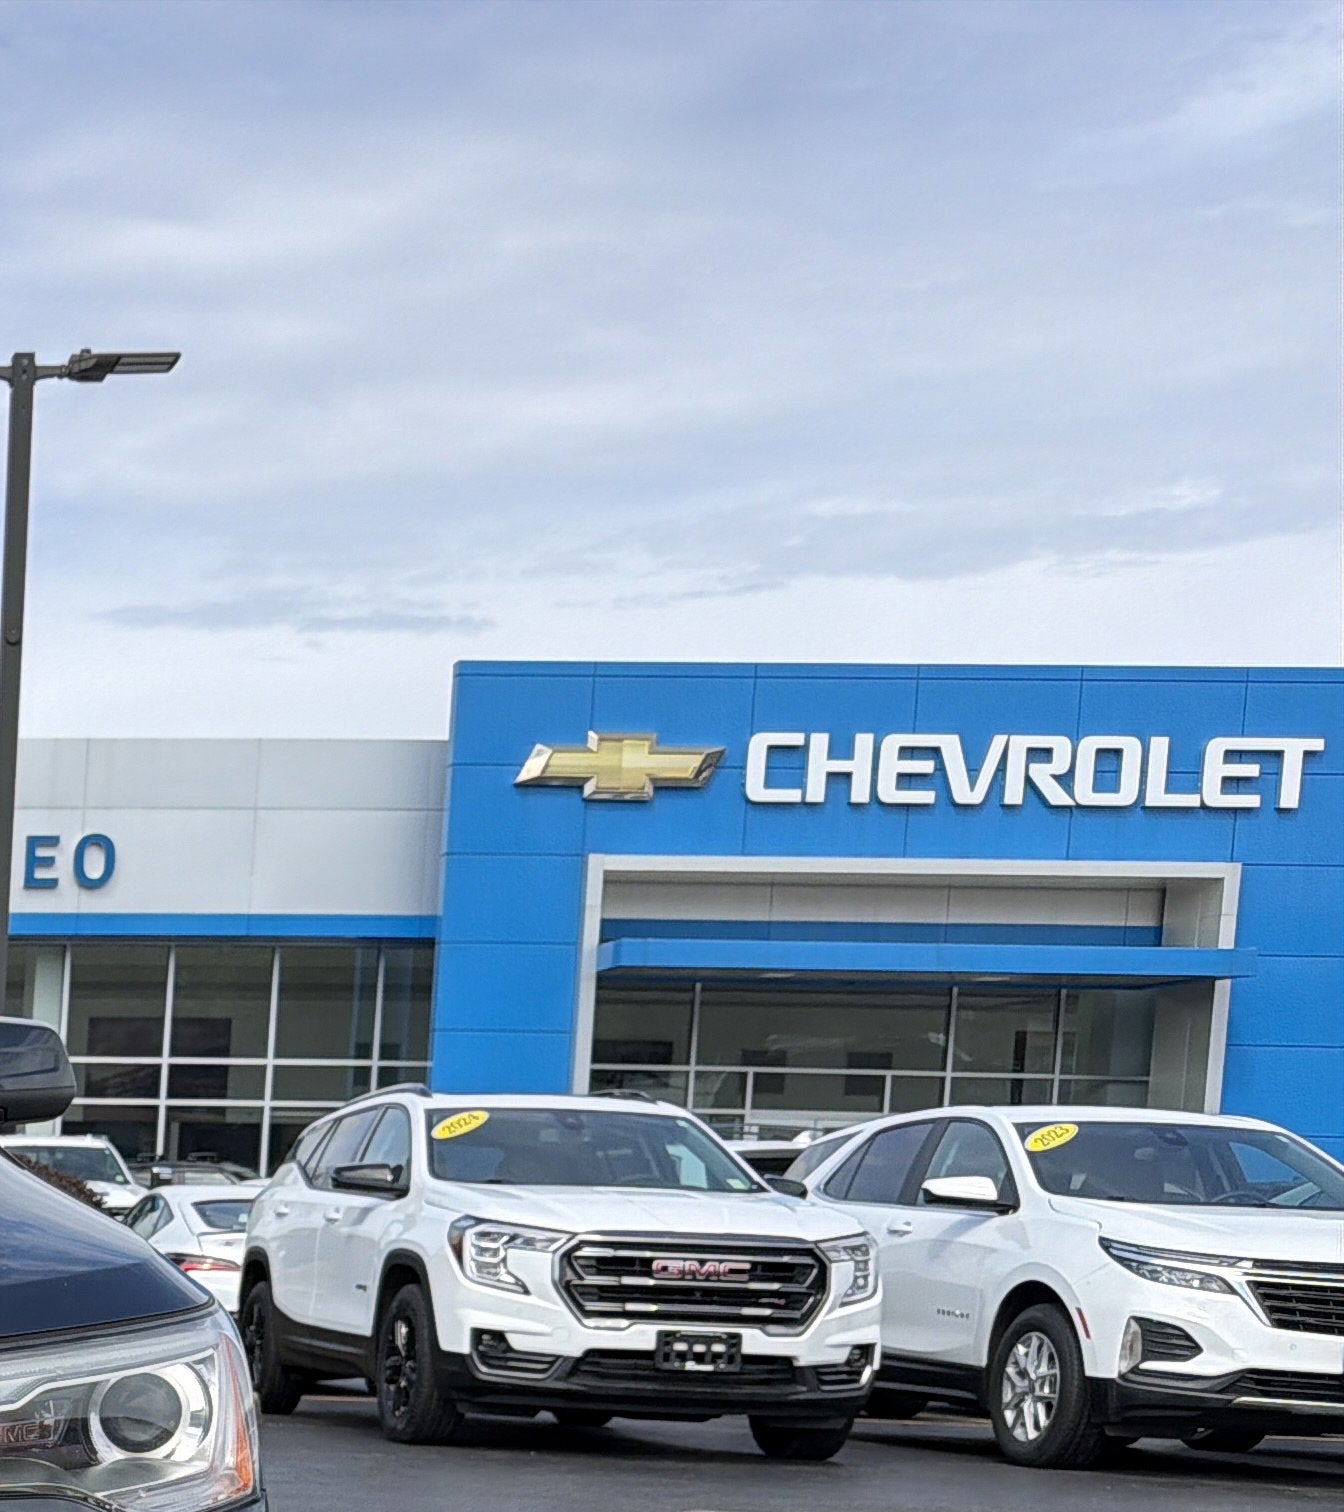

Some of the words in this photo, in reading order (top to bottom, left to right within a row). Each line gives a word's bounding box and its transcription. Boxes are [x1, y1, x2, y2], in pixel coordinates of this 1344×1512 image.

[744, 731, 1326, 810] CHEVROLET
[1033, 1126, 1070, 1147] 2023
[651, 1259, 752, 1281] GMC
